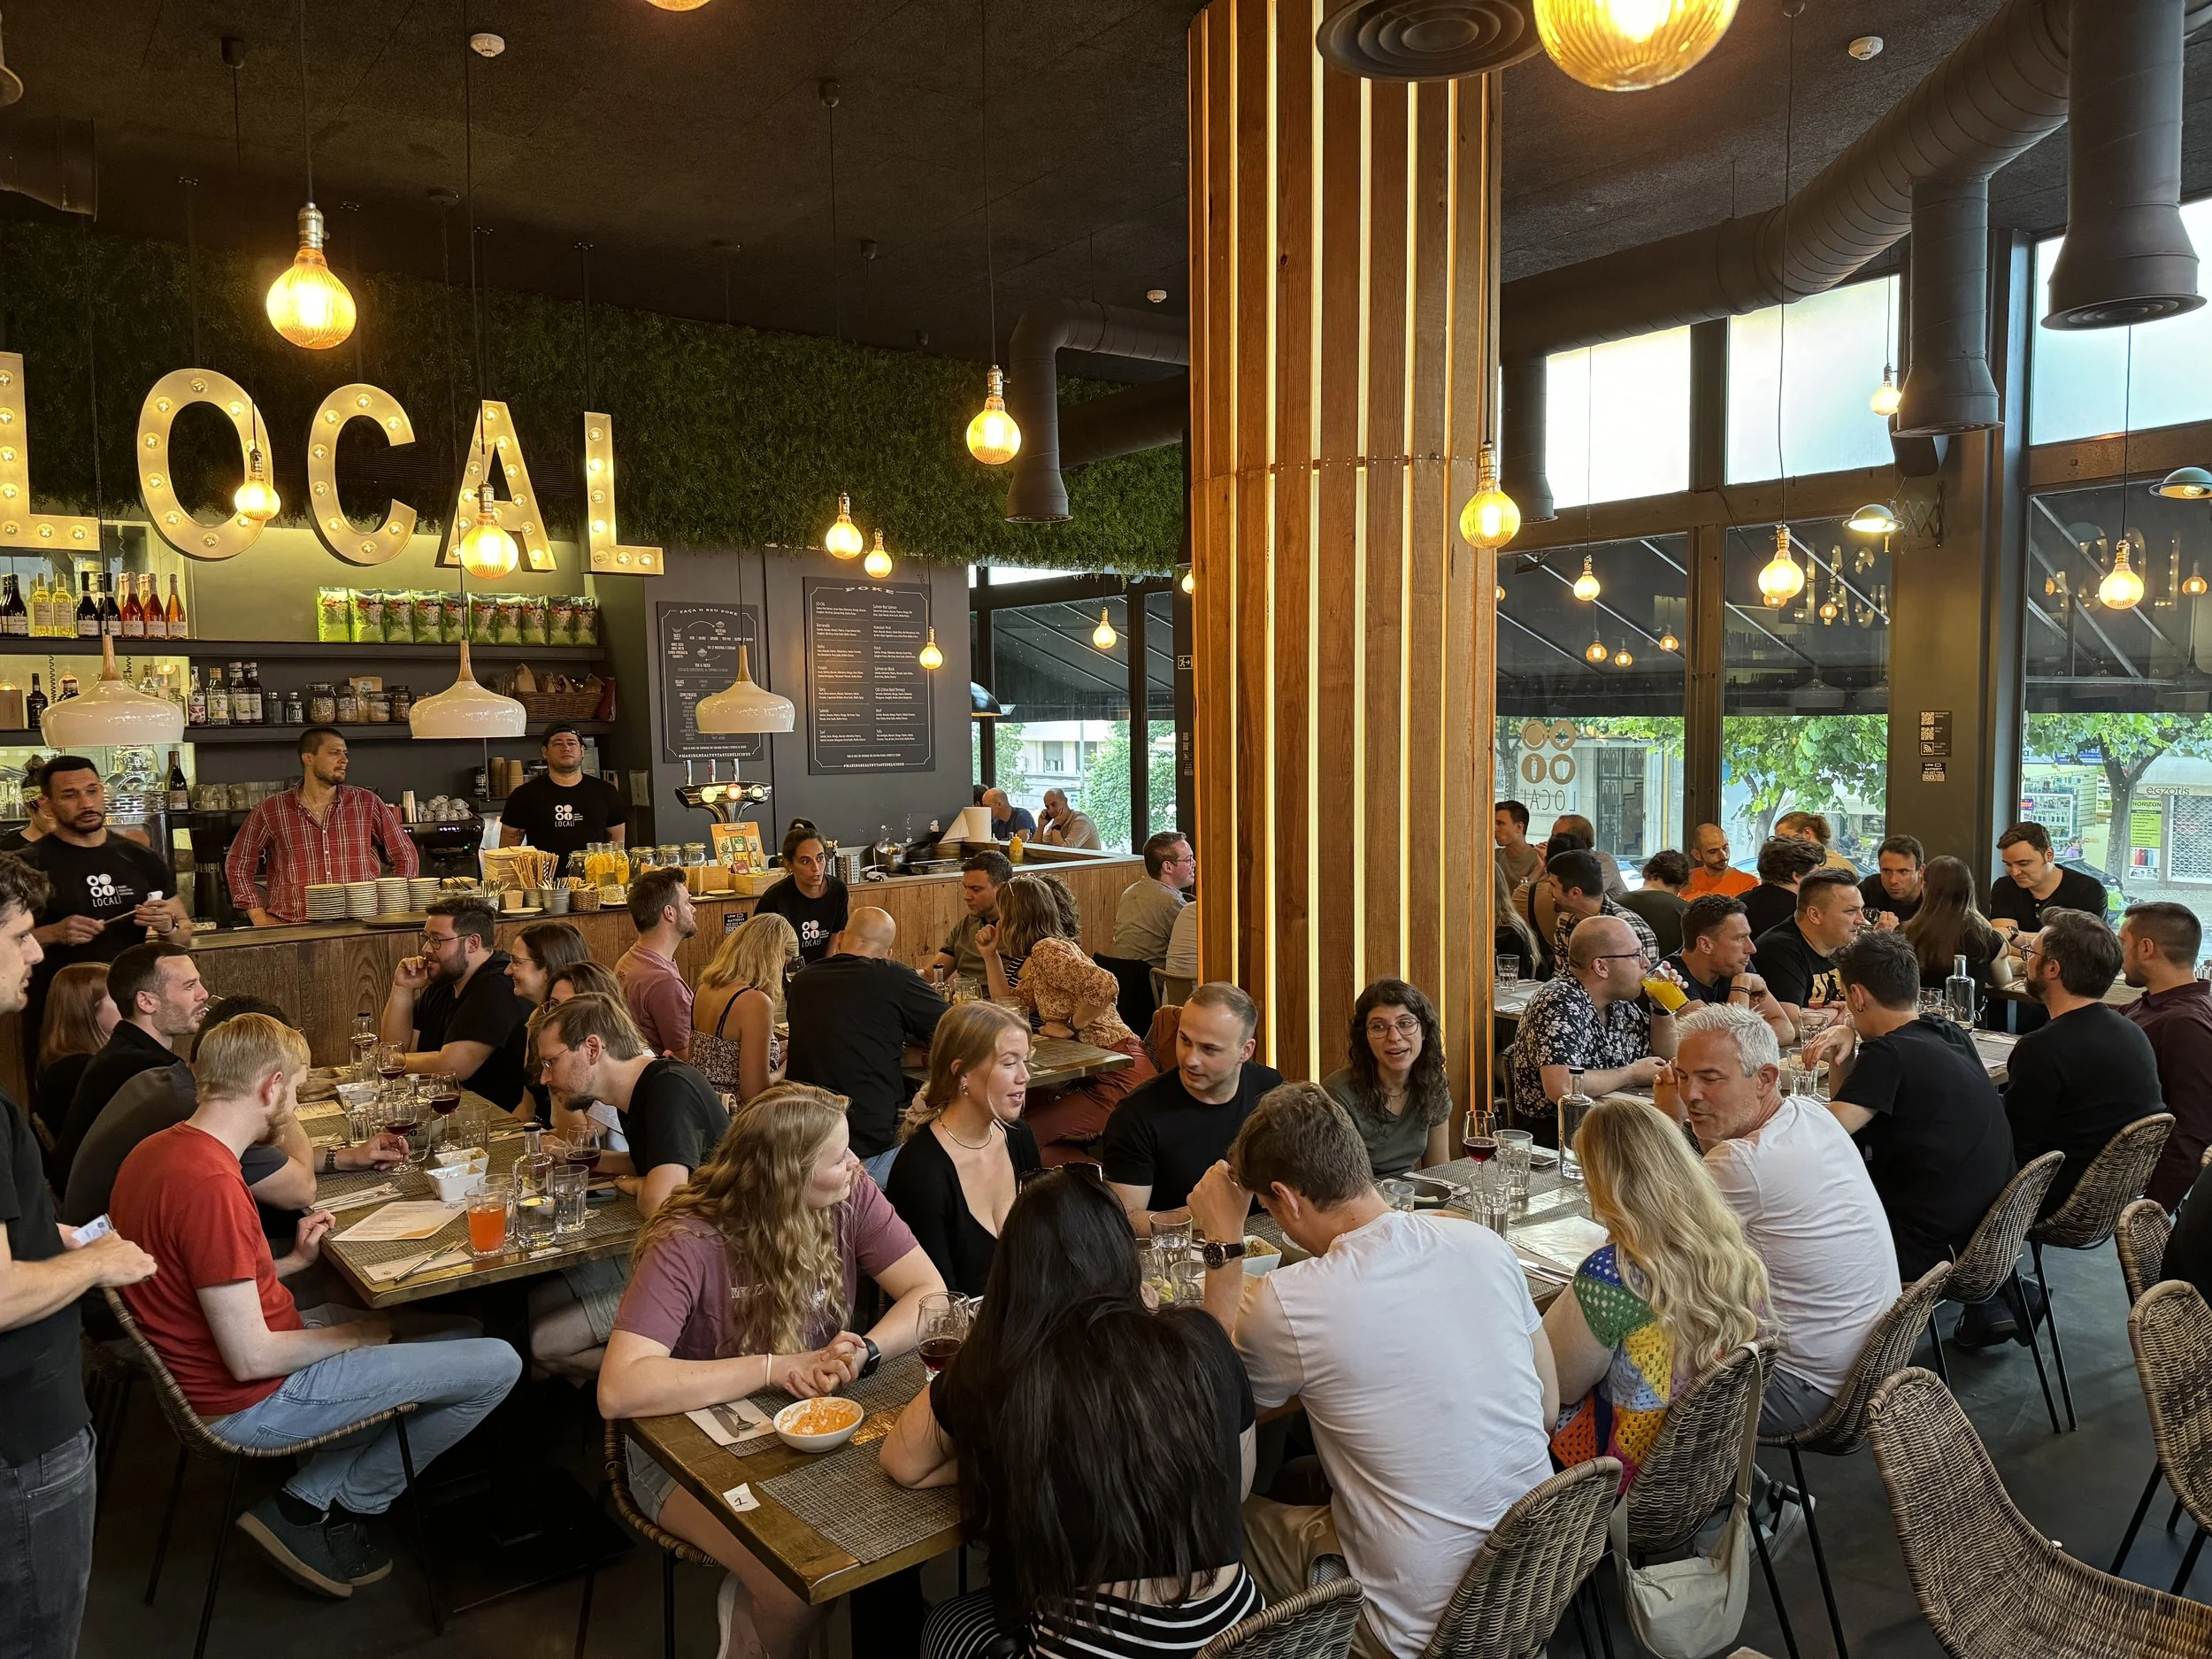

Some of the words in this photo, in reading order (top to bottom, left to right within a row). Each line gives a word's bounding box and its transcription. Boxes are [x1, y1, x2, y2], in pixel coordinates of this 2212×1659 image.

[0, 351, 664, 576] LOCAL
[845, 586, 894, 595] POKE
[92, 895, 118, 908] LOCAL
